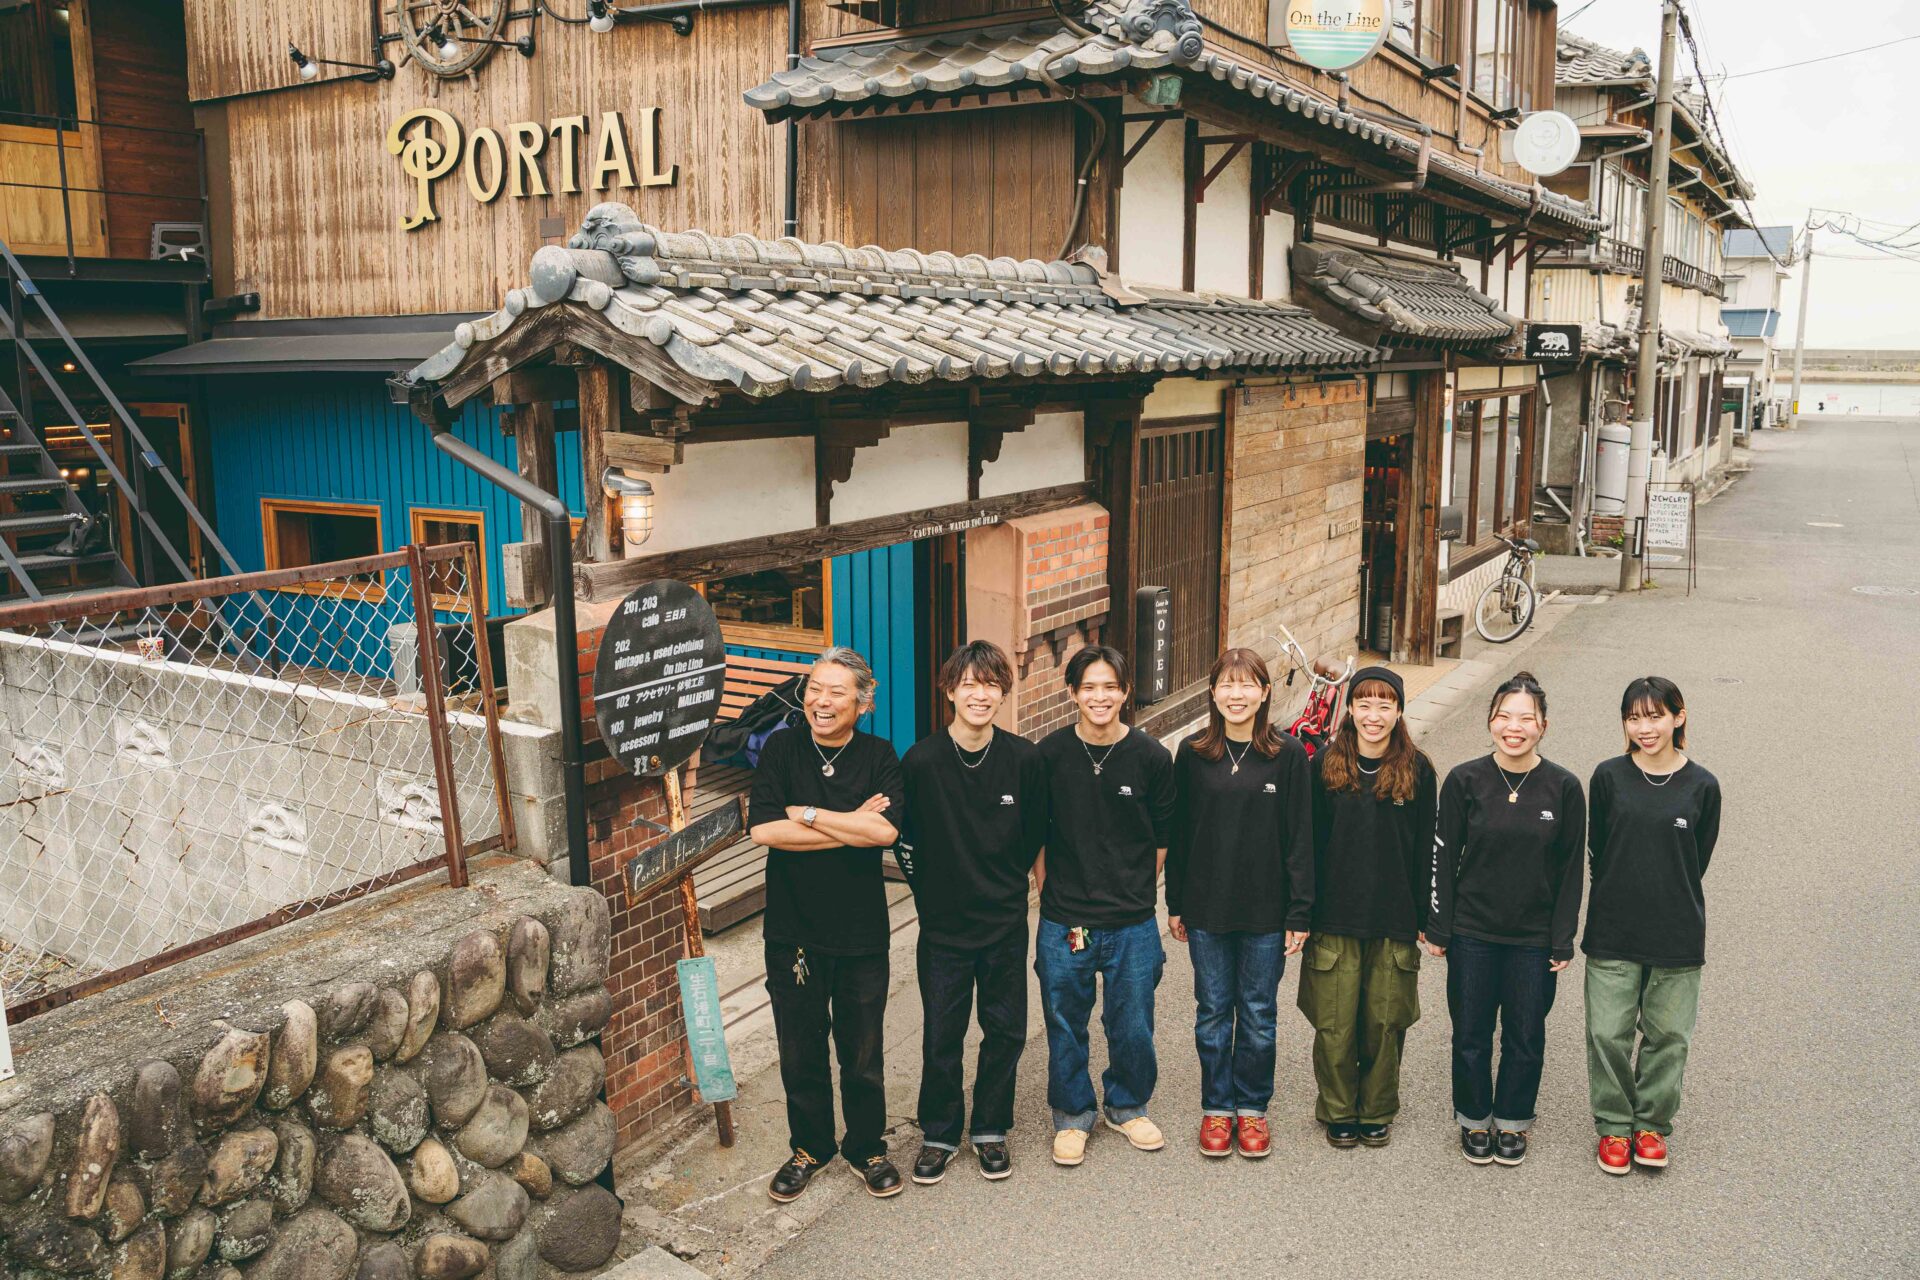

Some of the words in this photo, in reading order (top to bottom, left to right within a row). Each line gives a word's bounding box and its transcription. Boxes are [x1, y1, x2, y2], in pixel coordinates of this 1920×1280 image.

[1290, 10, 1312, 25] On
[1317, 10, 1341, 26] the
[1346, 12, 1381, 27] Line
[387, 107, 679, 231] PORTAL
[1651, 495, 1687, 503] JEWELRY
[913, 525, 943, 539] CAUTION
[949, 520, 970, 531] WATCH
[982, 514, 998, 525] HEAD
[664, 608, 687, 622] 三日月
[614, 639, 631, 653] 202
[614, 655, 643, 670] vintage
[653, 645, 672, 660] used
[673, 639, 705, 655] clothing
[1156, 618, 1166, 691] OPEN
[663, 664, 675, 676] On
[675, 660, 687, 674] the
[688, 657, 704, 671] Line
[616, 694, 631, 709] 102
[635, 685, 675, 703] アクセサリー
[678, 688, 716, 709] MALLIEYAN
[610, 720, 625, 735] 103
[633, 710, 664, 730] jewelry
[620, 732, 661, 753] accessory
[668, 718, 710, 740] masamune
[700, 819, 723, 852] guide
